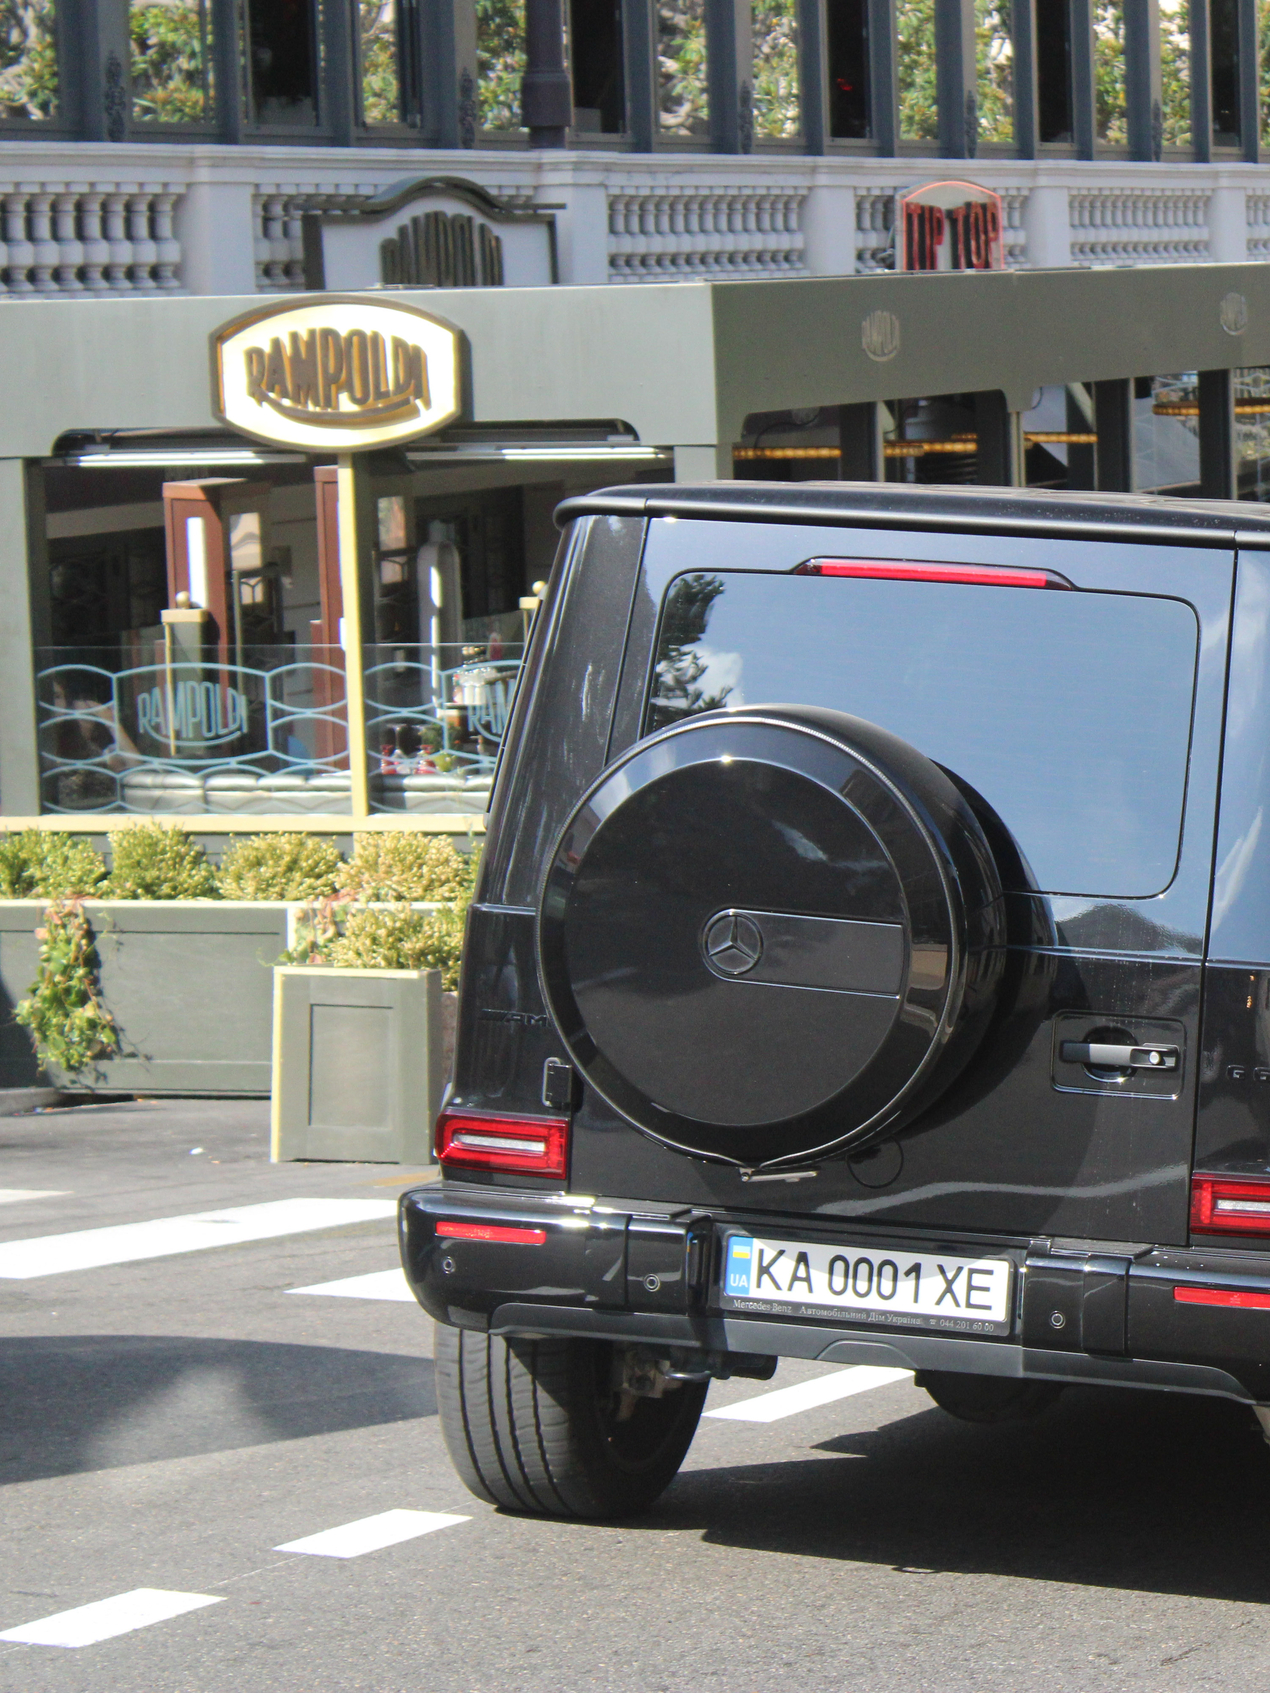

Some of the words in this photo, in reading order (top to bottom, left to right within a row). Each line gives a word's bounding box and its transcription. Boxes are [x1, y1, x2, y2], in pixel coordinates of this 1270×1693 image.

[905, 201, 944, 269] TIP
[946, 201, 999, 269] TOP
[244, 326, 431, 424] RAMPOLDI
[137, 680, 248, 745] RAMPOLDI
[1226, 1064, 1246, 1082] G
[730, 1273, 748, 1288] UA
[733, 1299, 792, 1313] Mercedes-Benz
[756, 1248, 814, 1294] KA
[828, 1254, 922, 1304] 0001
[934, 1264, 994, 1311] XE
